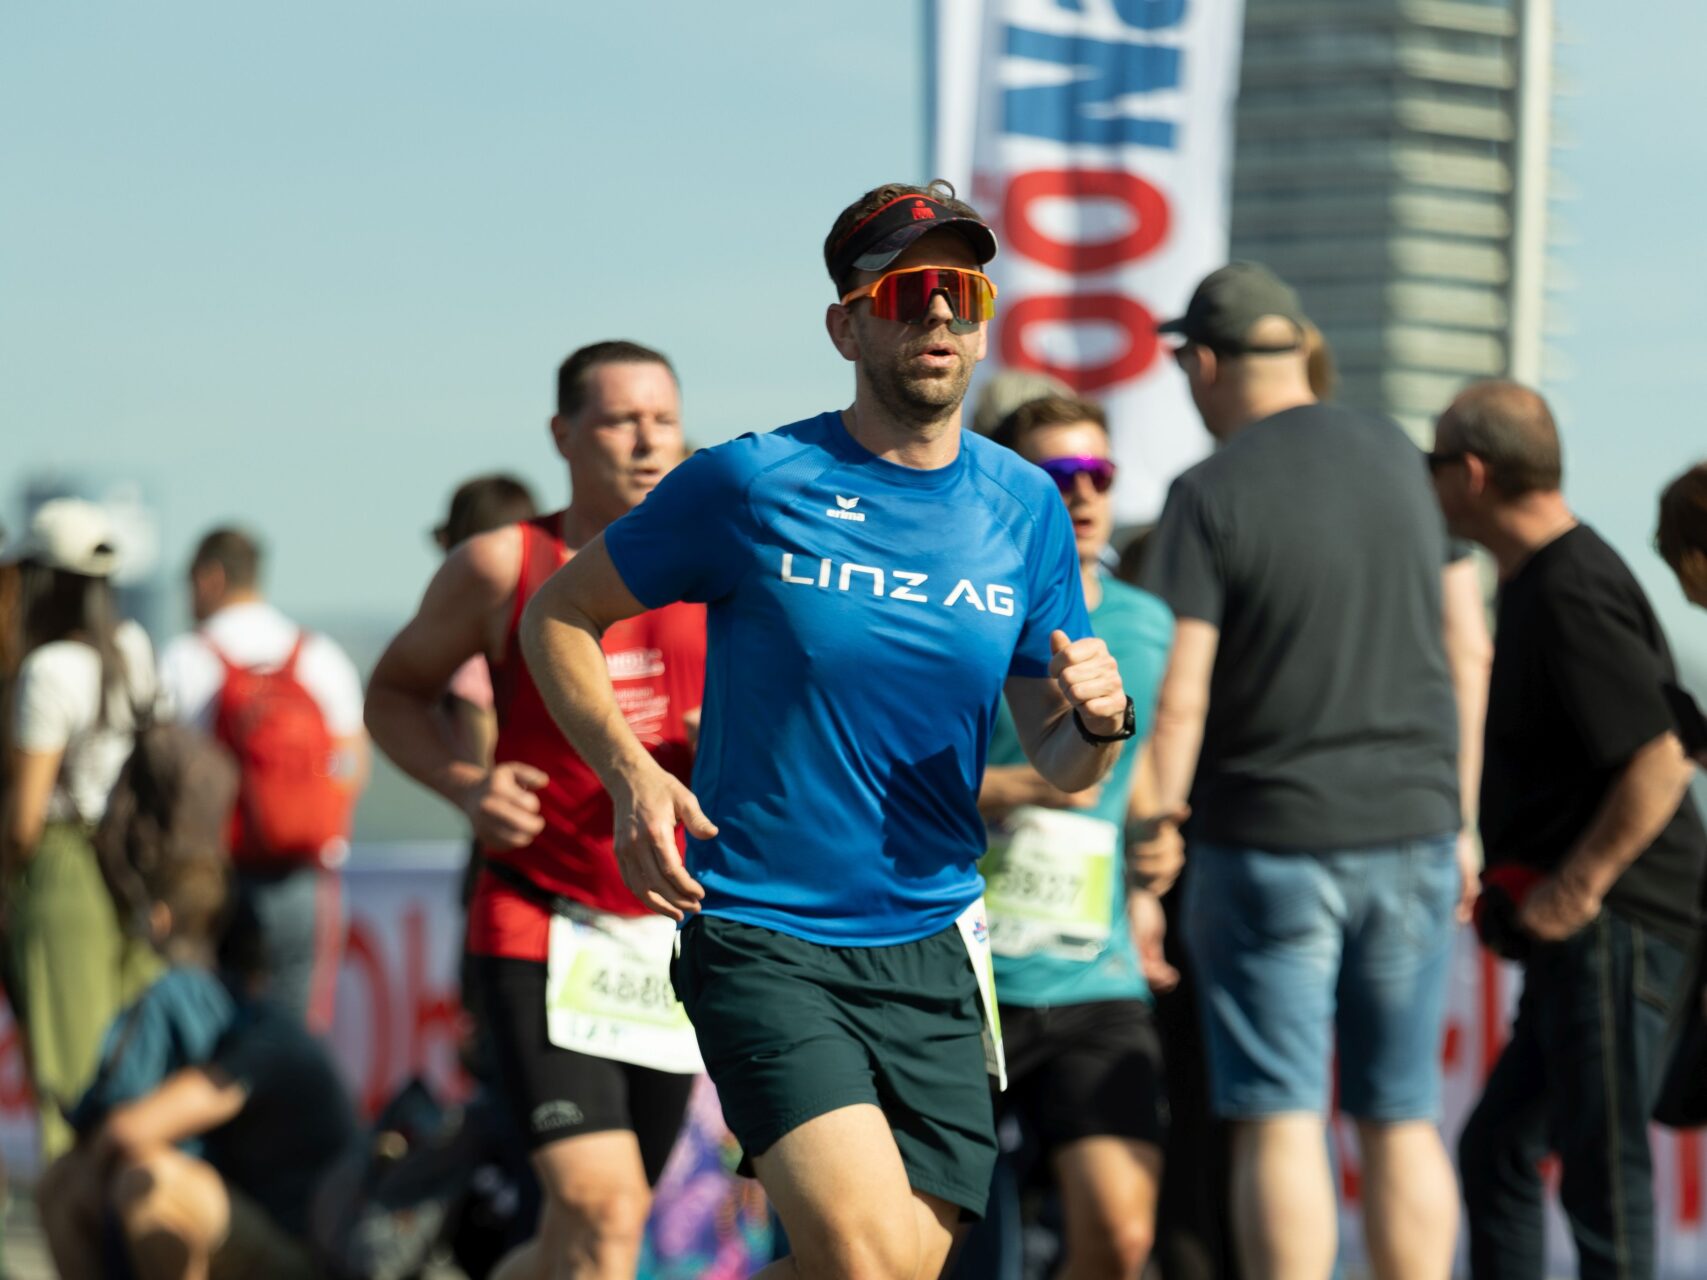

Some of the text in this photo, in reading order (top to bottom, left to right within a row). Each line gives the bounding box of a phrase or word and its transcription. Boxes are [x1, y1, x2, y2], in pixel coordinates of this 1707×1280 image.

[826, 508, 866, 523] erima
[781, 552, 1015, 617] LINZ AG
